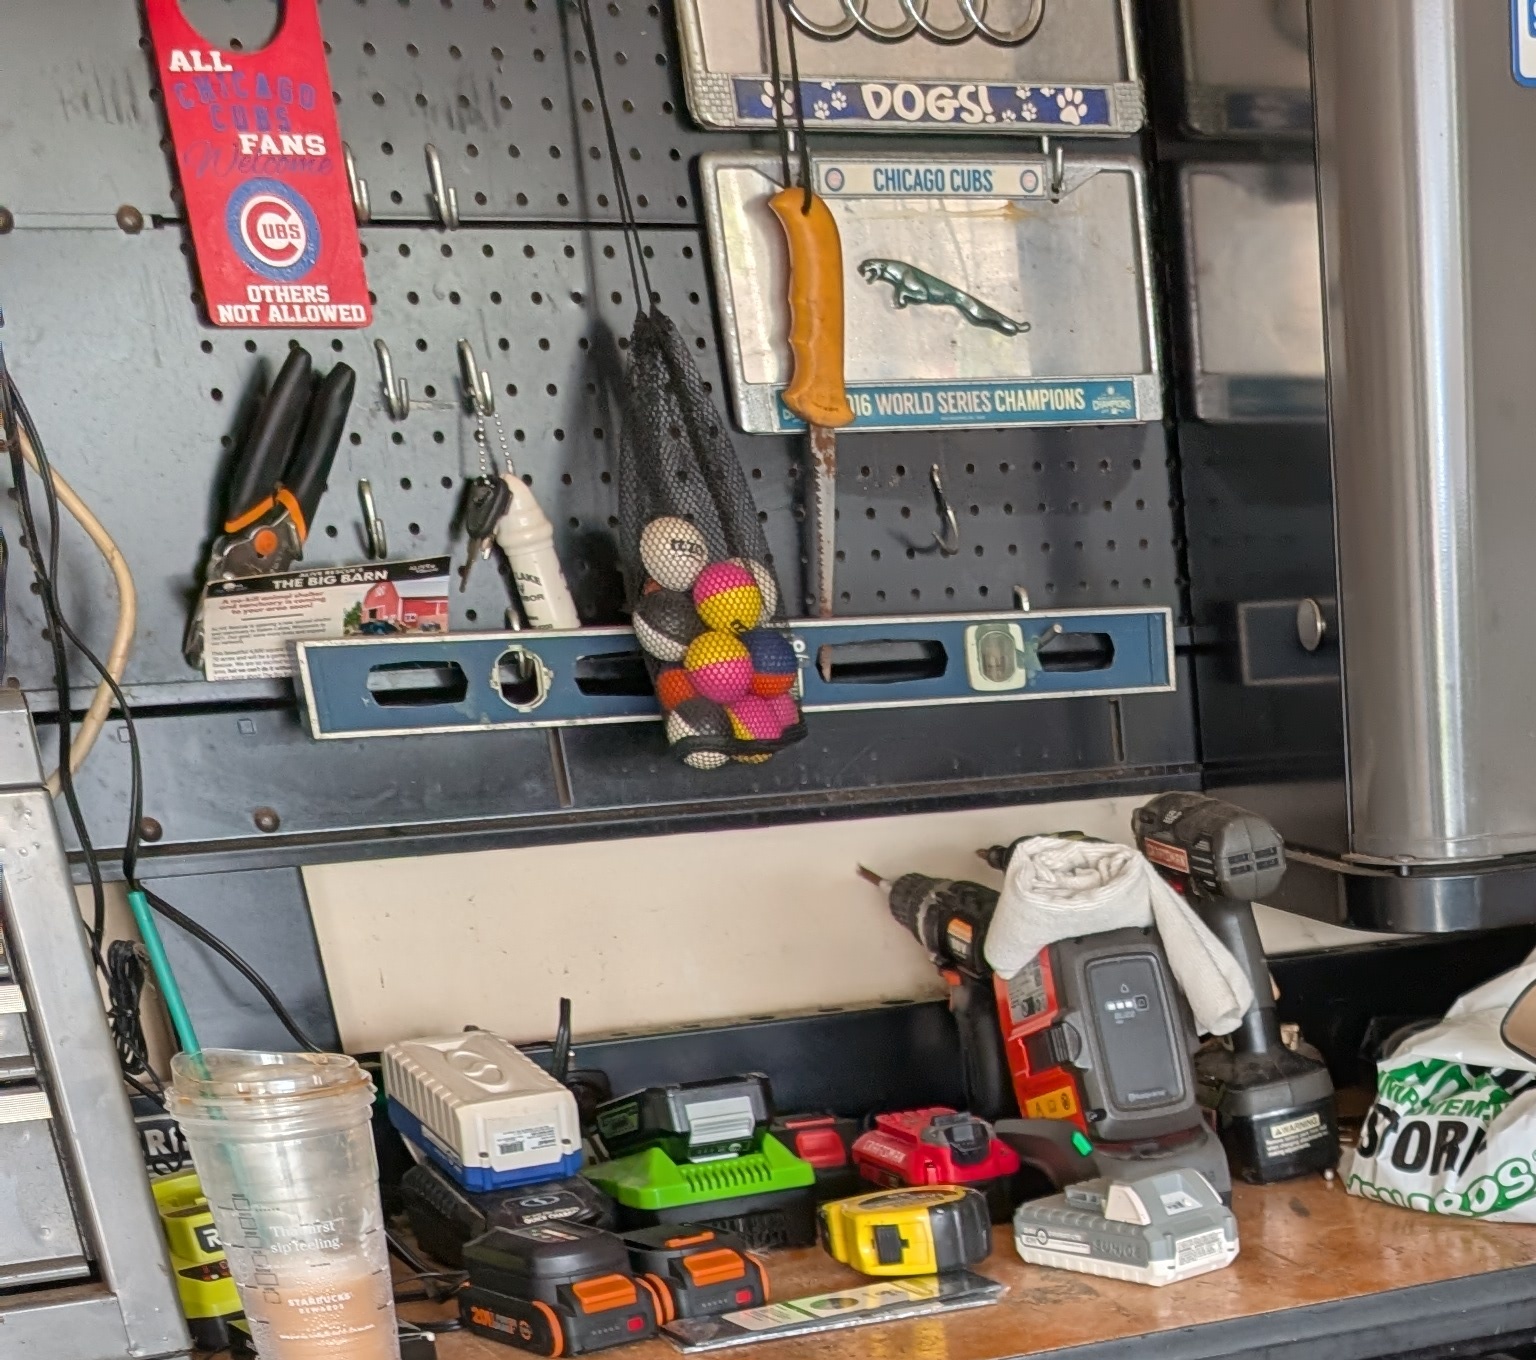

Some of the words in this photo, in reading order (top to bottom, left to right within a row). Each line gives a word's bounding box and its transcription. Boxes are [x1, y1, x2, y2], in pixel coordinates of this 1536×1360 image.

[169, 50, 233, 72] ALL
[173, 71, 315, 110] CHICAGO
[860, 84, 997, 124] DOGS!
[209, 102, 292, 133] CUBS
[239, 134, 326, 155] FANS
[184, 139, 333, 177] Welcome
[873, 168, 945, 192] CHICAGO
[949, 168, 994, 192] CUBS
[247, 285, 329, 303] OTHERS
[217, 305, 260, 323] NOT
[268, 304, 366, 322] ALLOWED
[875, 391, 934, 415] WORLD
[938, 390, 993, 414] SERIES
[995, 389, 1085, 412] CHAMPIONS
[272, 578, 304, 590] THE
[307, 575, 337, 587] BIG
[340, 569, 388, 585] BARN
[287, 1292, 351, 1307] STARBUCKS
